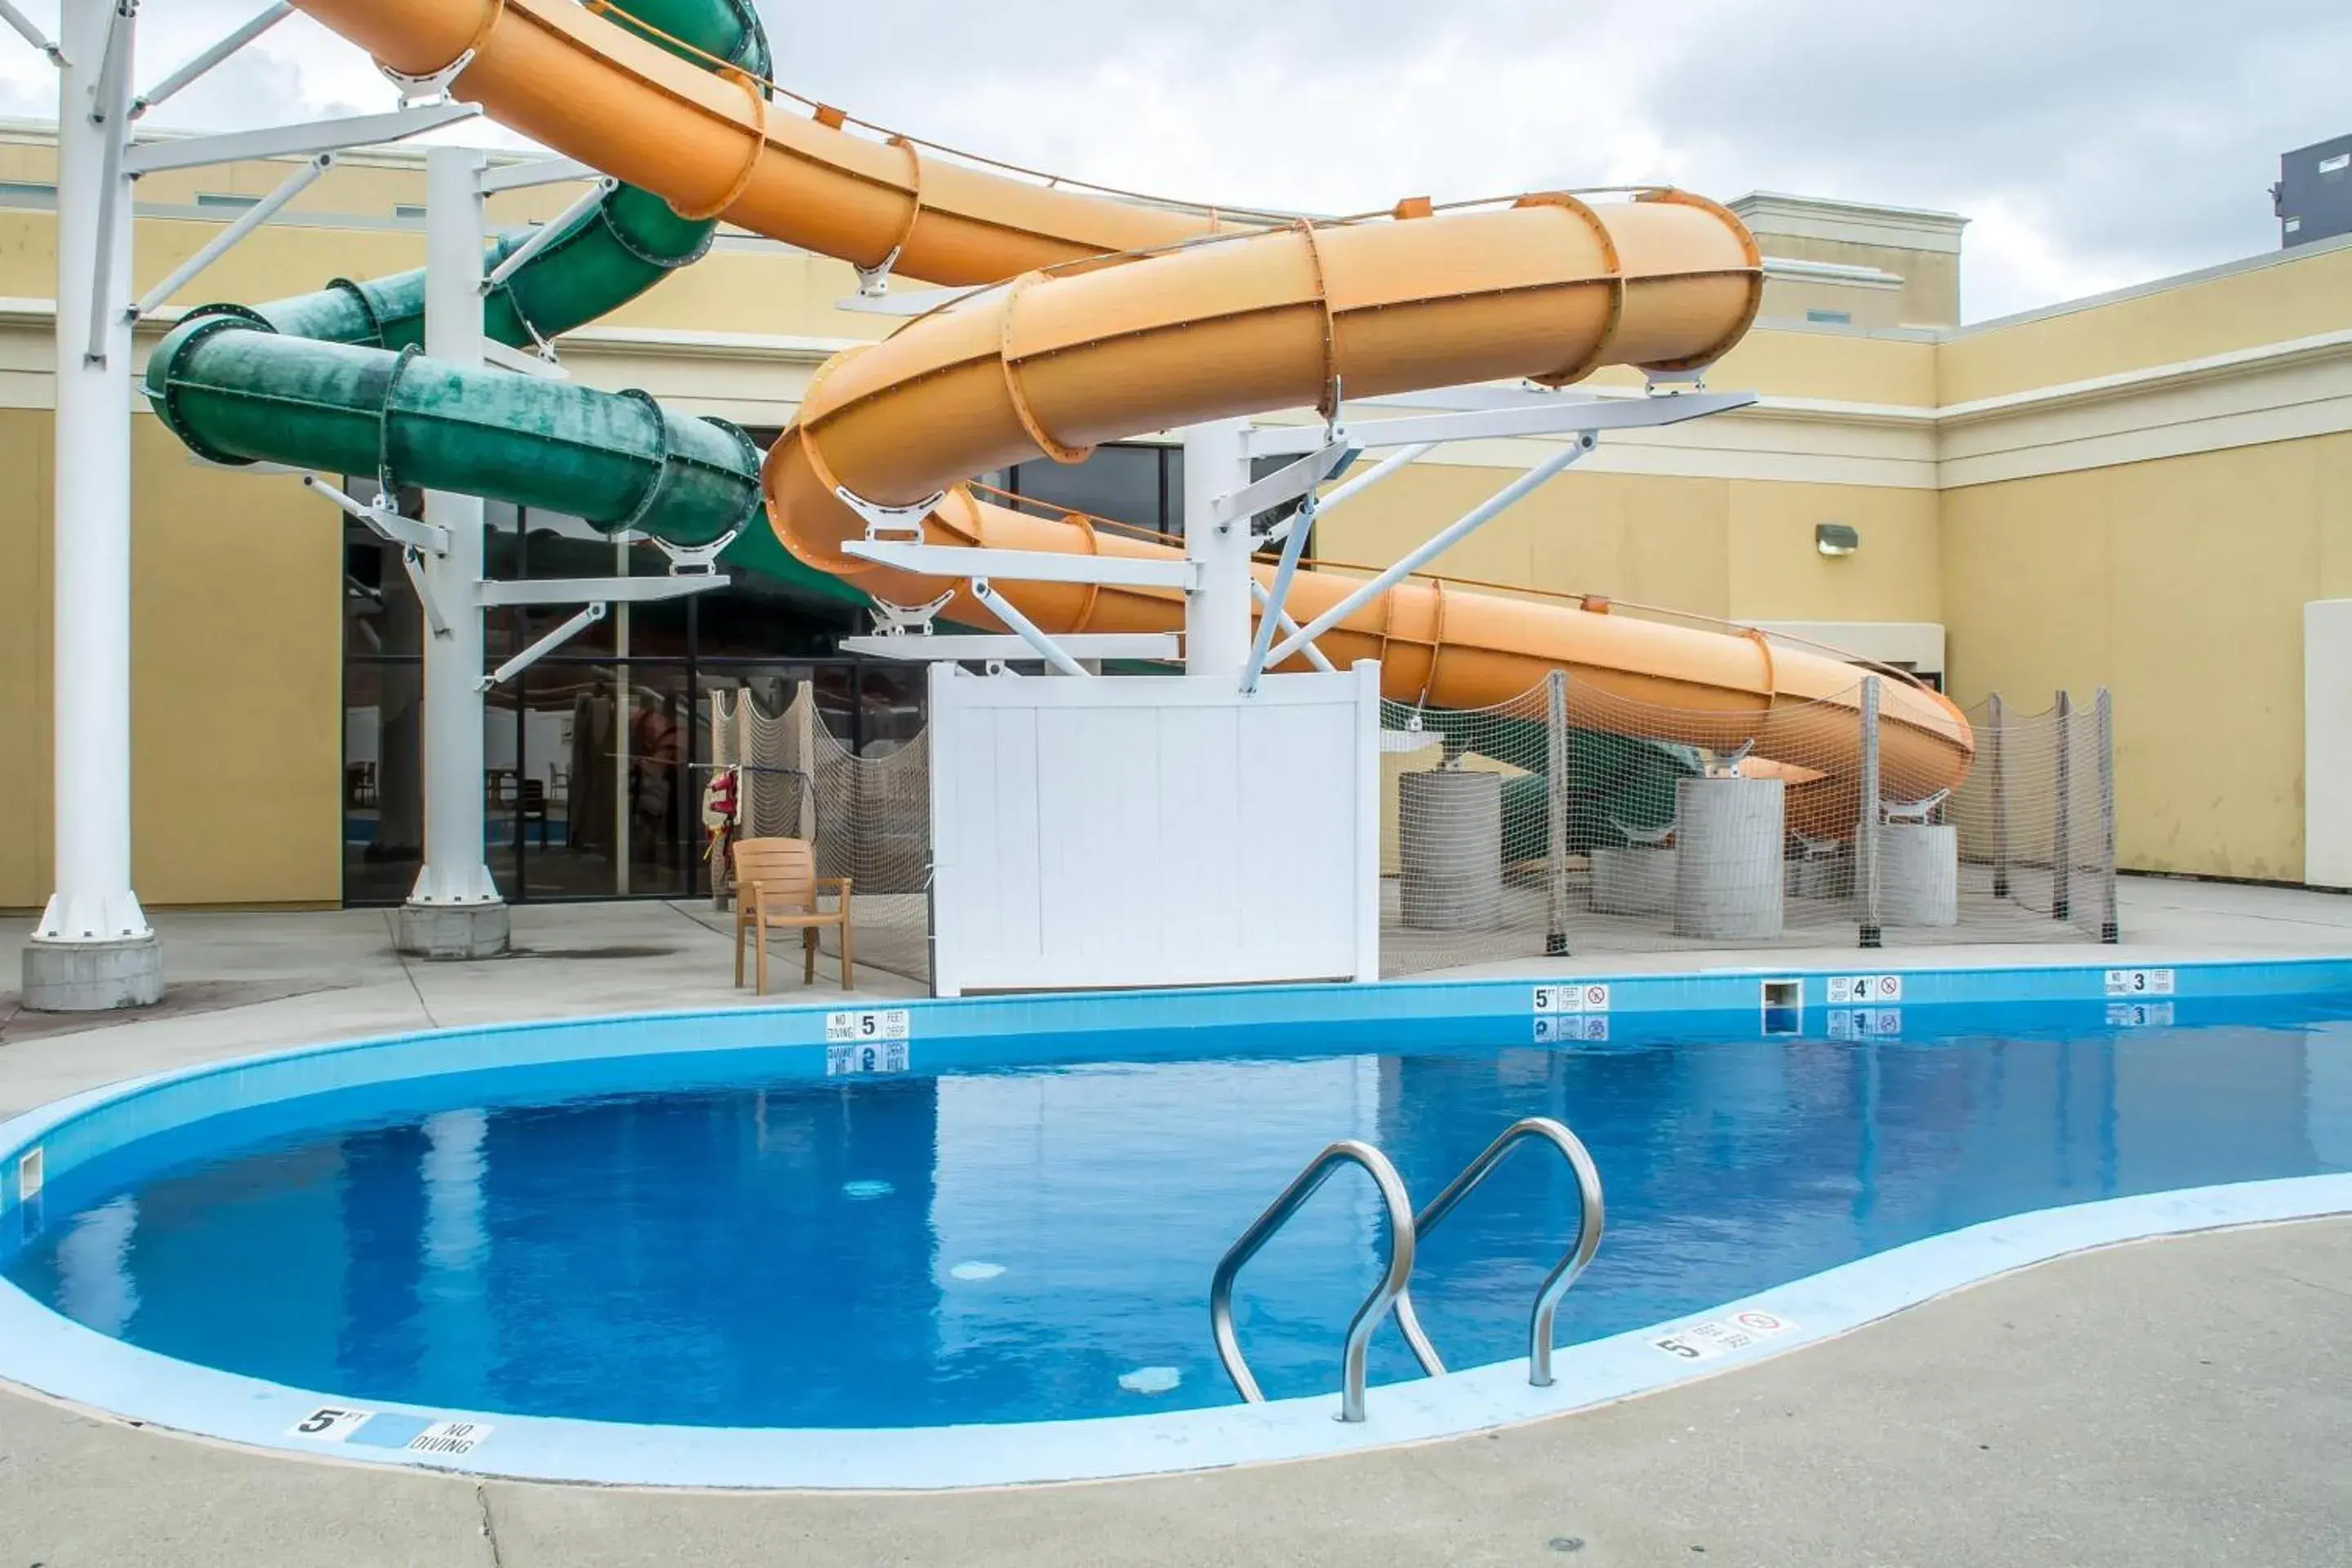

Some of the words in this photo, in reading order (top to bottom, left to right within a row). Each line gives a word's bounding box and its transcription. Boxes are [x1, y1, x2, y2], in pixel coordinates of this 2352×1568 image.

[1854, 979, 1866, 998] 4
[2134, 973, 2145, 991] 3
[1535, 988, 1548, 1008] 5
[835, 1013, 846, 1026] NO
[862, 1015, 875, 1036] 5
[827, 1026, 853, 1039] DIVING
[1656, 1340, 1699, 1357] 5
[298, 1409, 346, 1432] 5
[341, 1410, 366, 1422] FT
[442, 1423, 474, 1437] NO
[408, 1436, 474, 1454] DIVING
